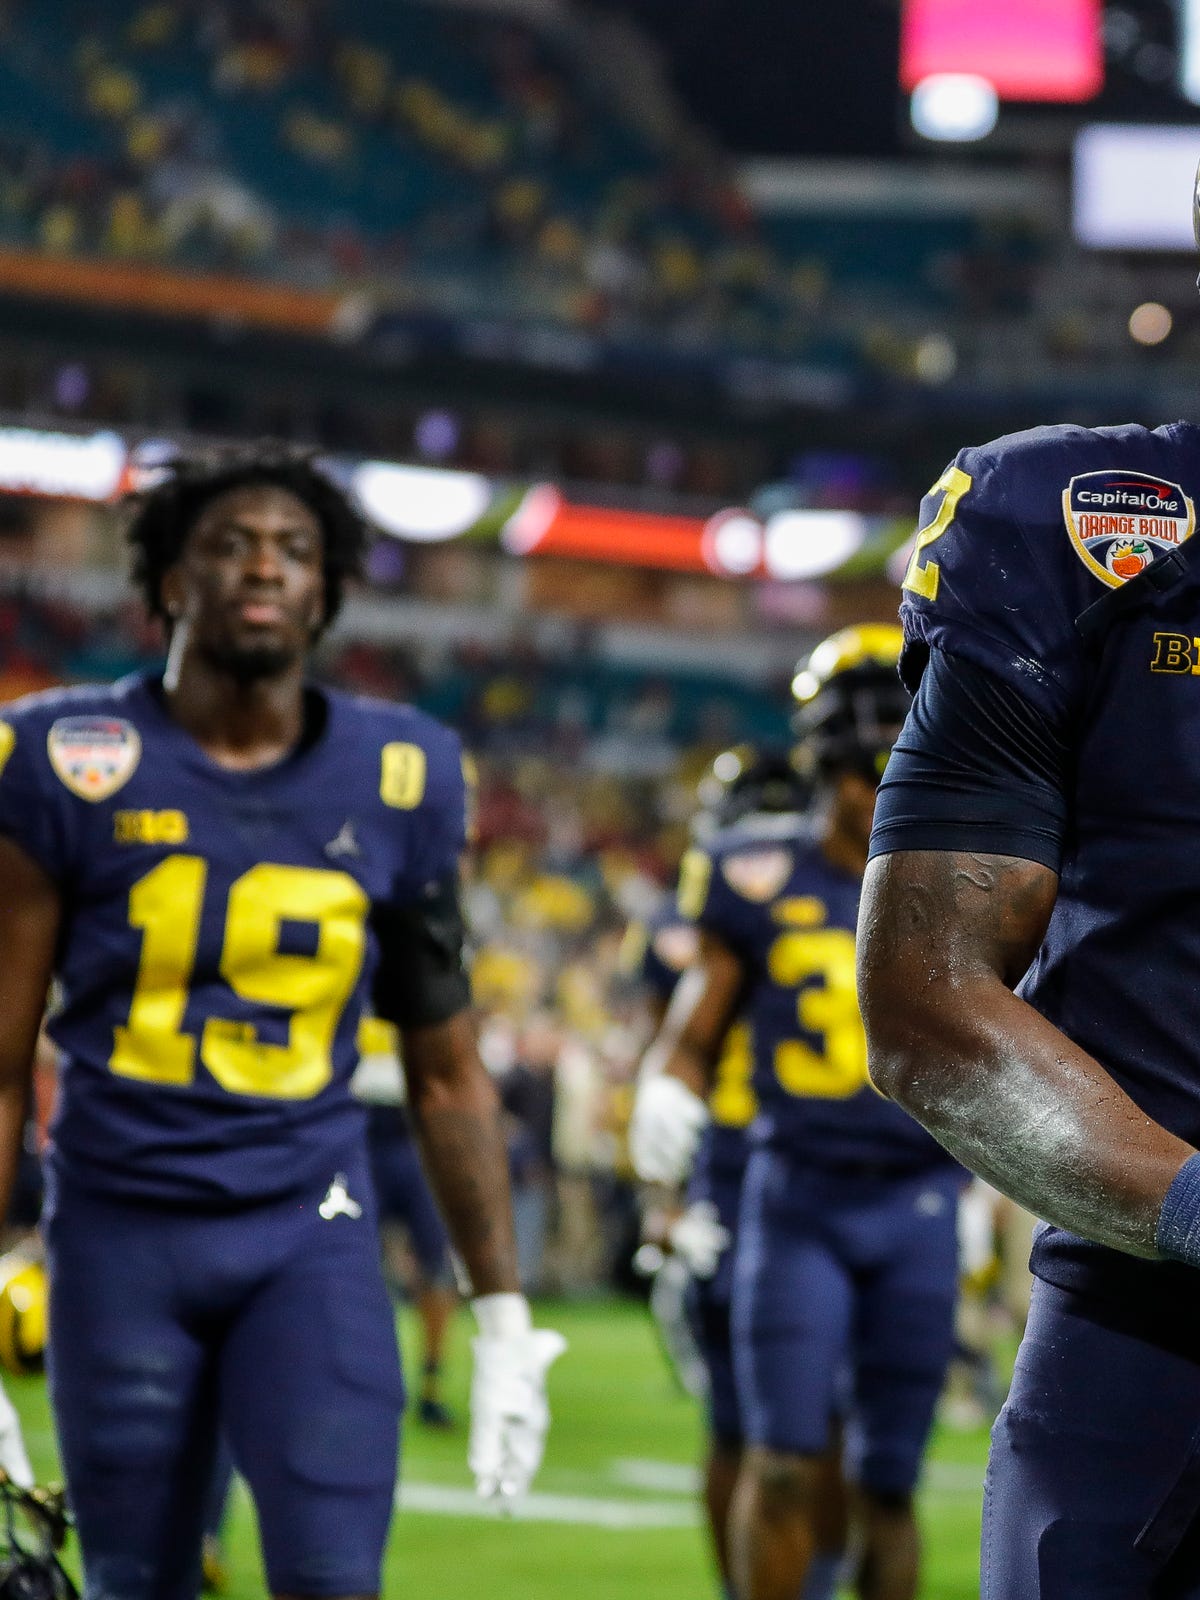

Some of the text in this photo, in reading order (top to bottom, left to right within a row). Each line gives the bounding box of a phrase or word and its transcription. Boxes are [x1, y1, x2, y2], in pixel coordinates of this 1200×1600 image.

[902, 466, 972, 601] 2
[1079, 514, 1181, 544] ORANGE BOWL
[109, 853, 371, 1100] 19
